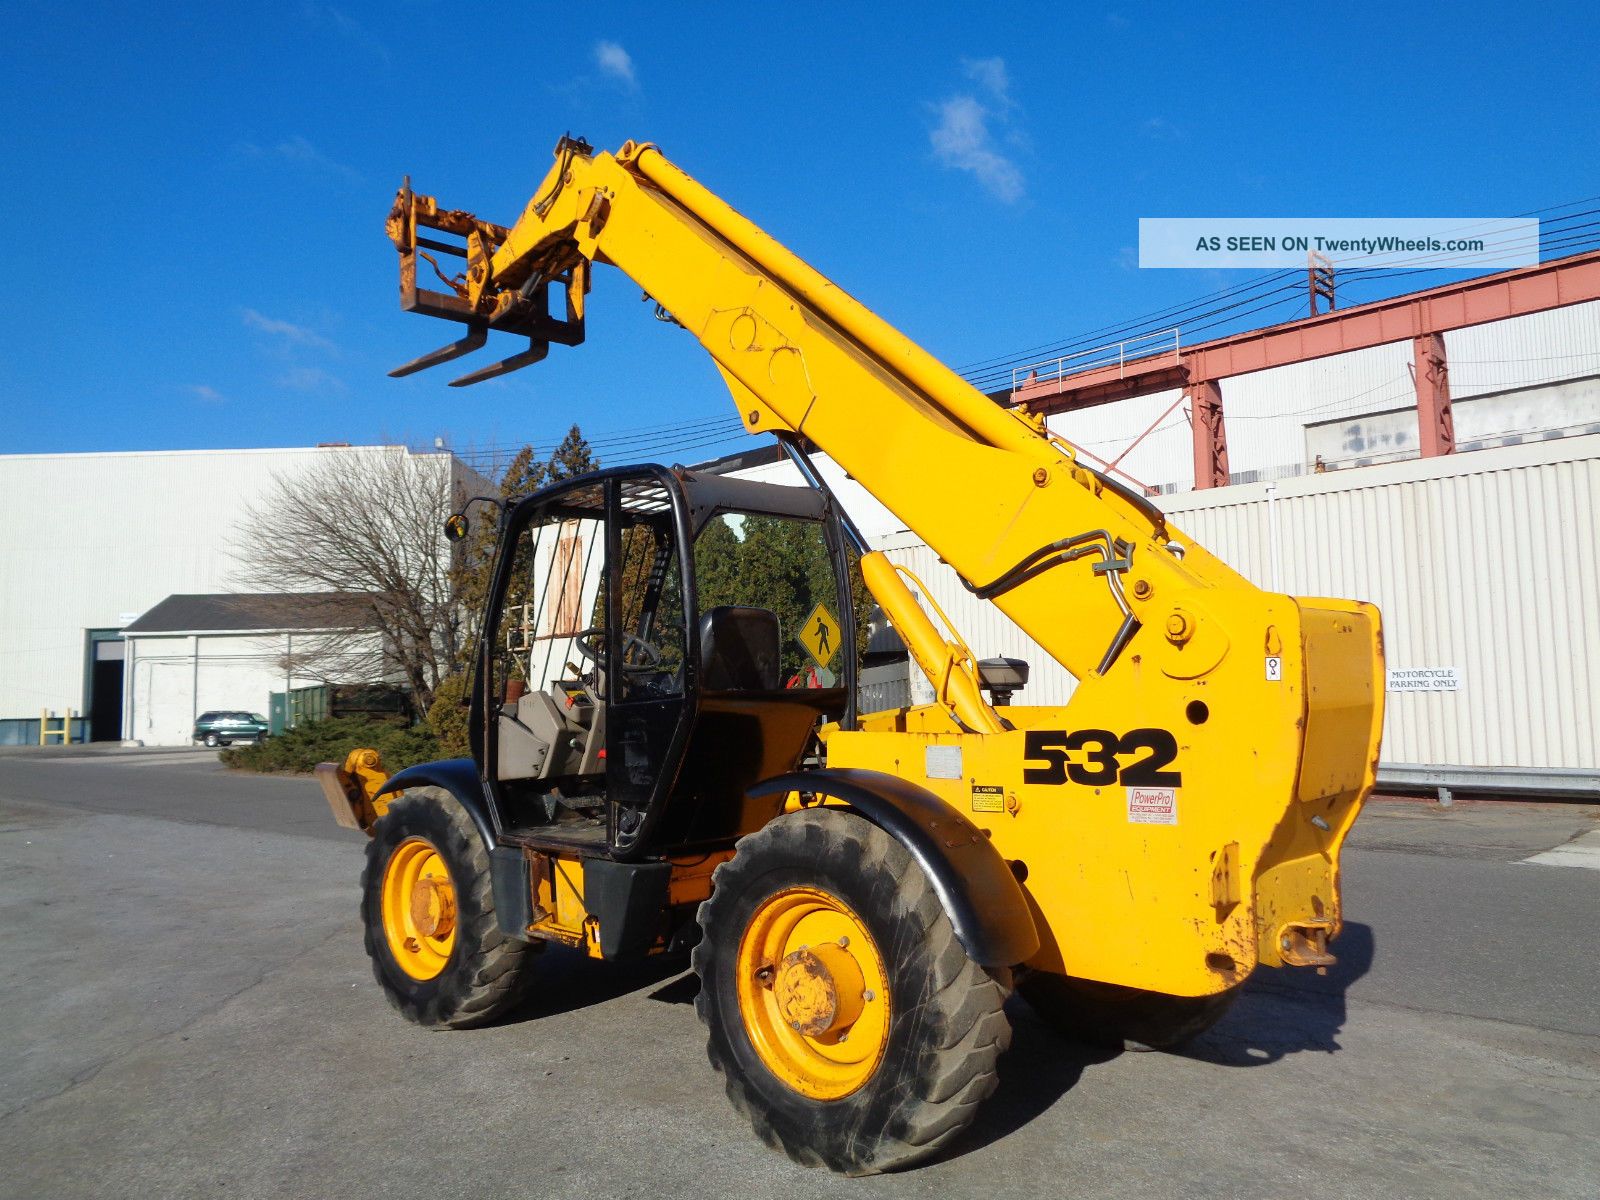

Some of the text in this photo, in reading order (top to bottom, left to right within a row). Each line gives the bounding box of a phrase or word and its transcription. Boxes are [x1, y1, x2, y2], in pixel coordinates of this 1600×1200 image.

[1392, 670, 1454, 678] MOTORCYCLE
[1390, 679, 1458, 688] PARKING ONLY
[1023, 728, 1182, 787] 532
[1134, 791, 1170, 805] PowerPro
